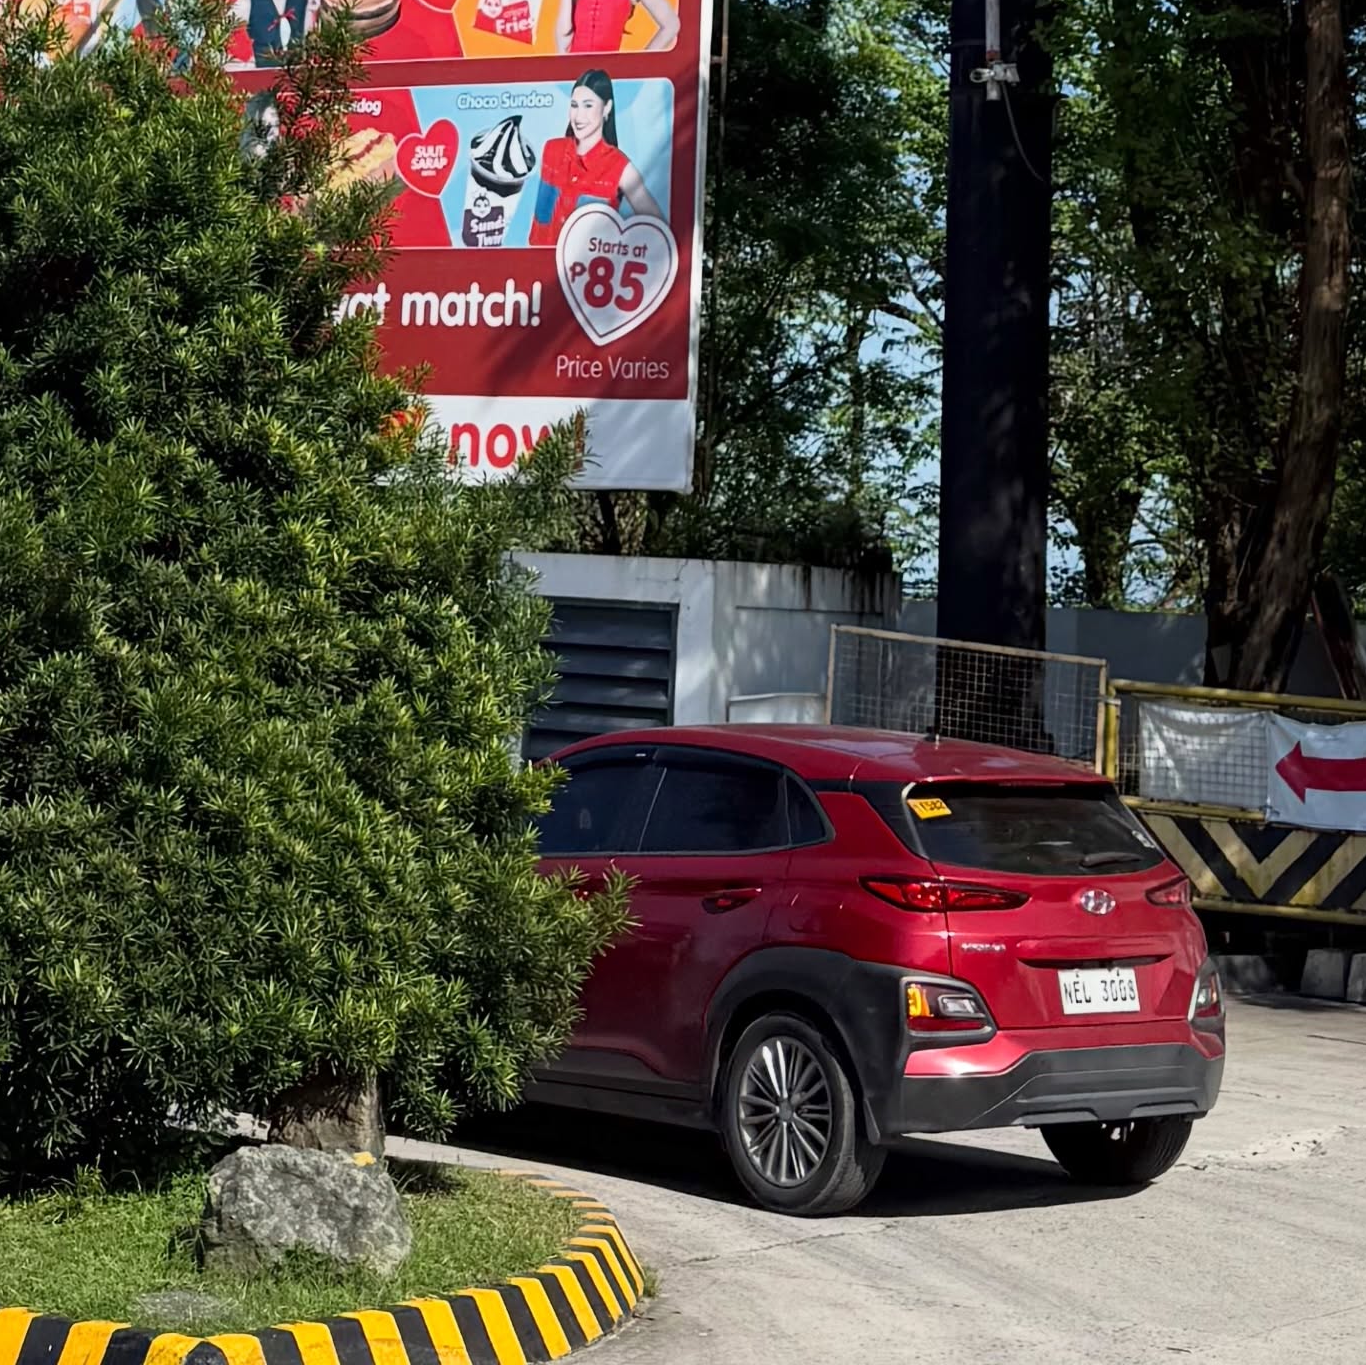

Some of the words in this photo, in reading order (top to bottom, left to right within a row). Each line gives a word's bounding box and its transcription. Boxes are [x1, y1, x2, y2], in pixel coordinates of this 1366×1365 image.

[495, 16, 535, 35] Fries
[457, 93, 498, 110] Choco
[500, 91, 554, 109] Sundae
[588, 237, 629, 256] Starts
[632, 242, 649, 259] at
[401, 278, 542, 327] match!
[556, 355, 603, 378] Price
[607, 355, 670, 379] Varies
[1063, 980, 1092, 1005] NEL
